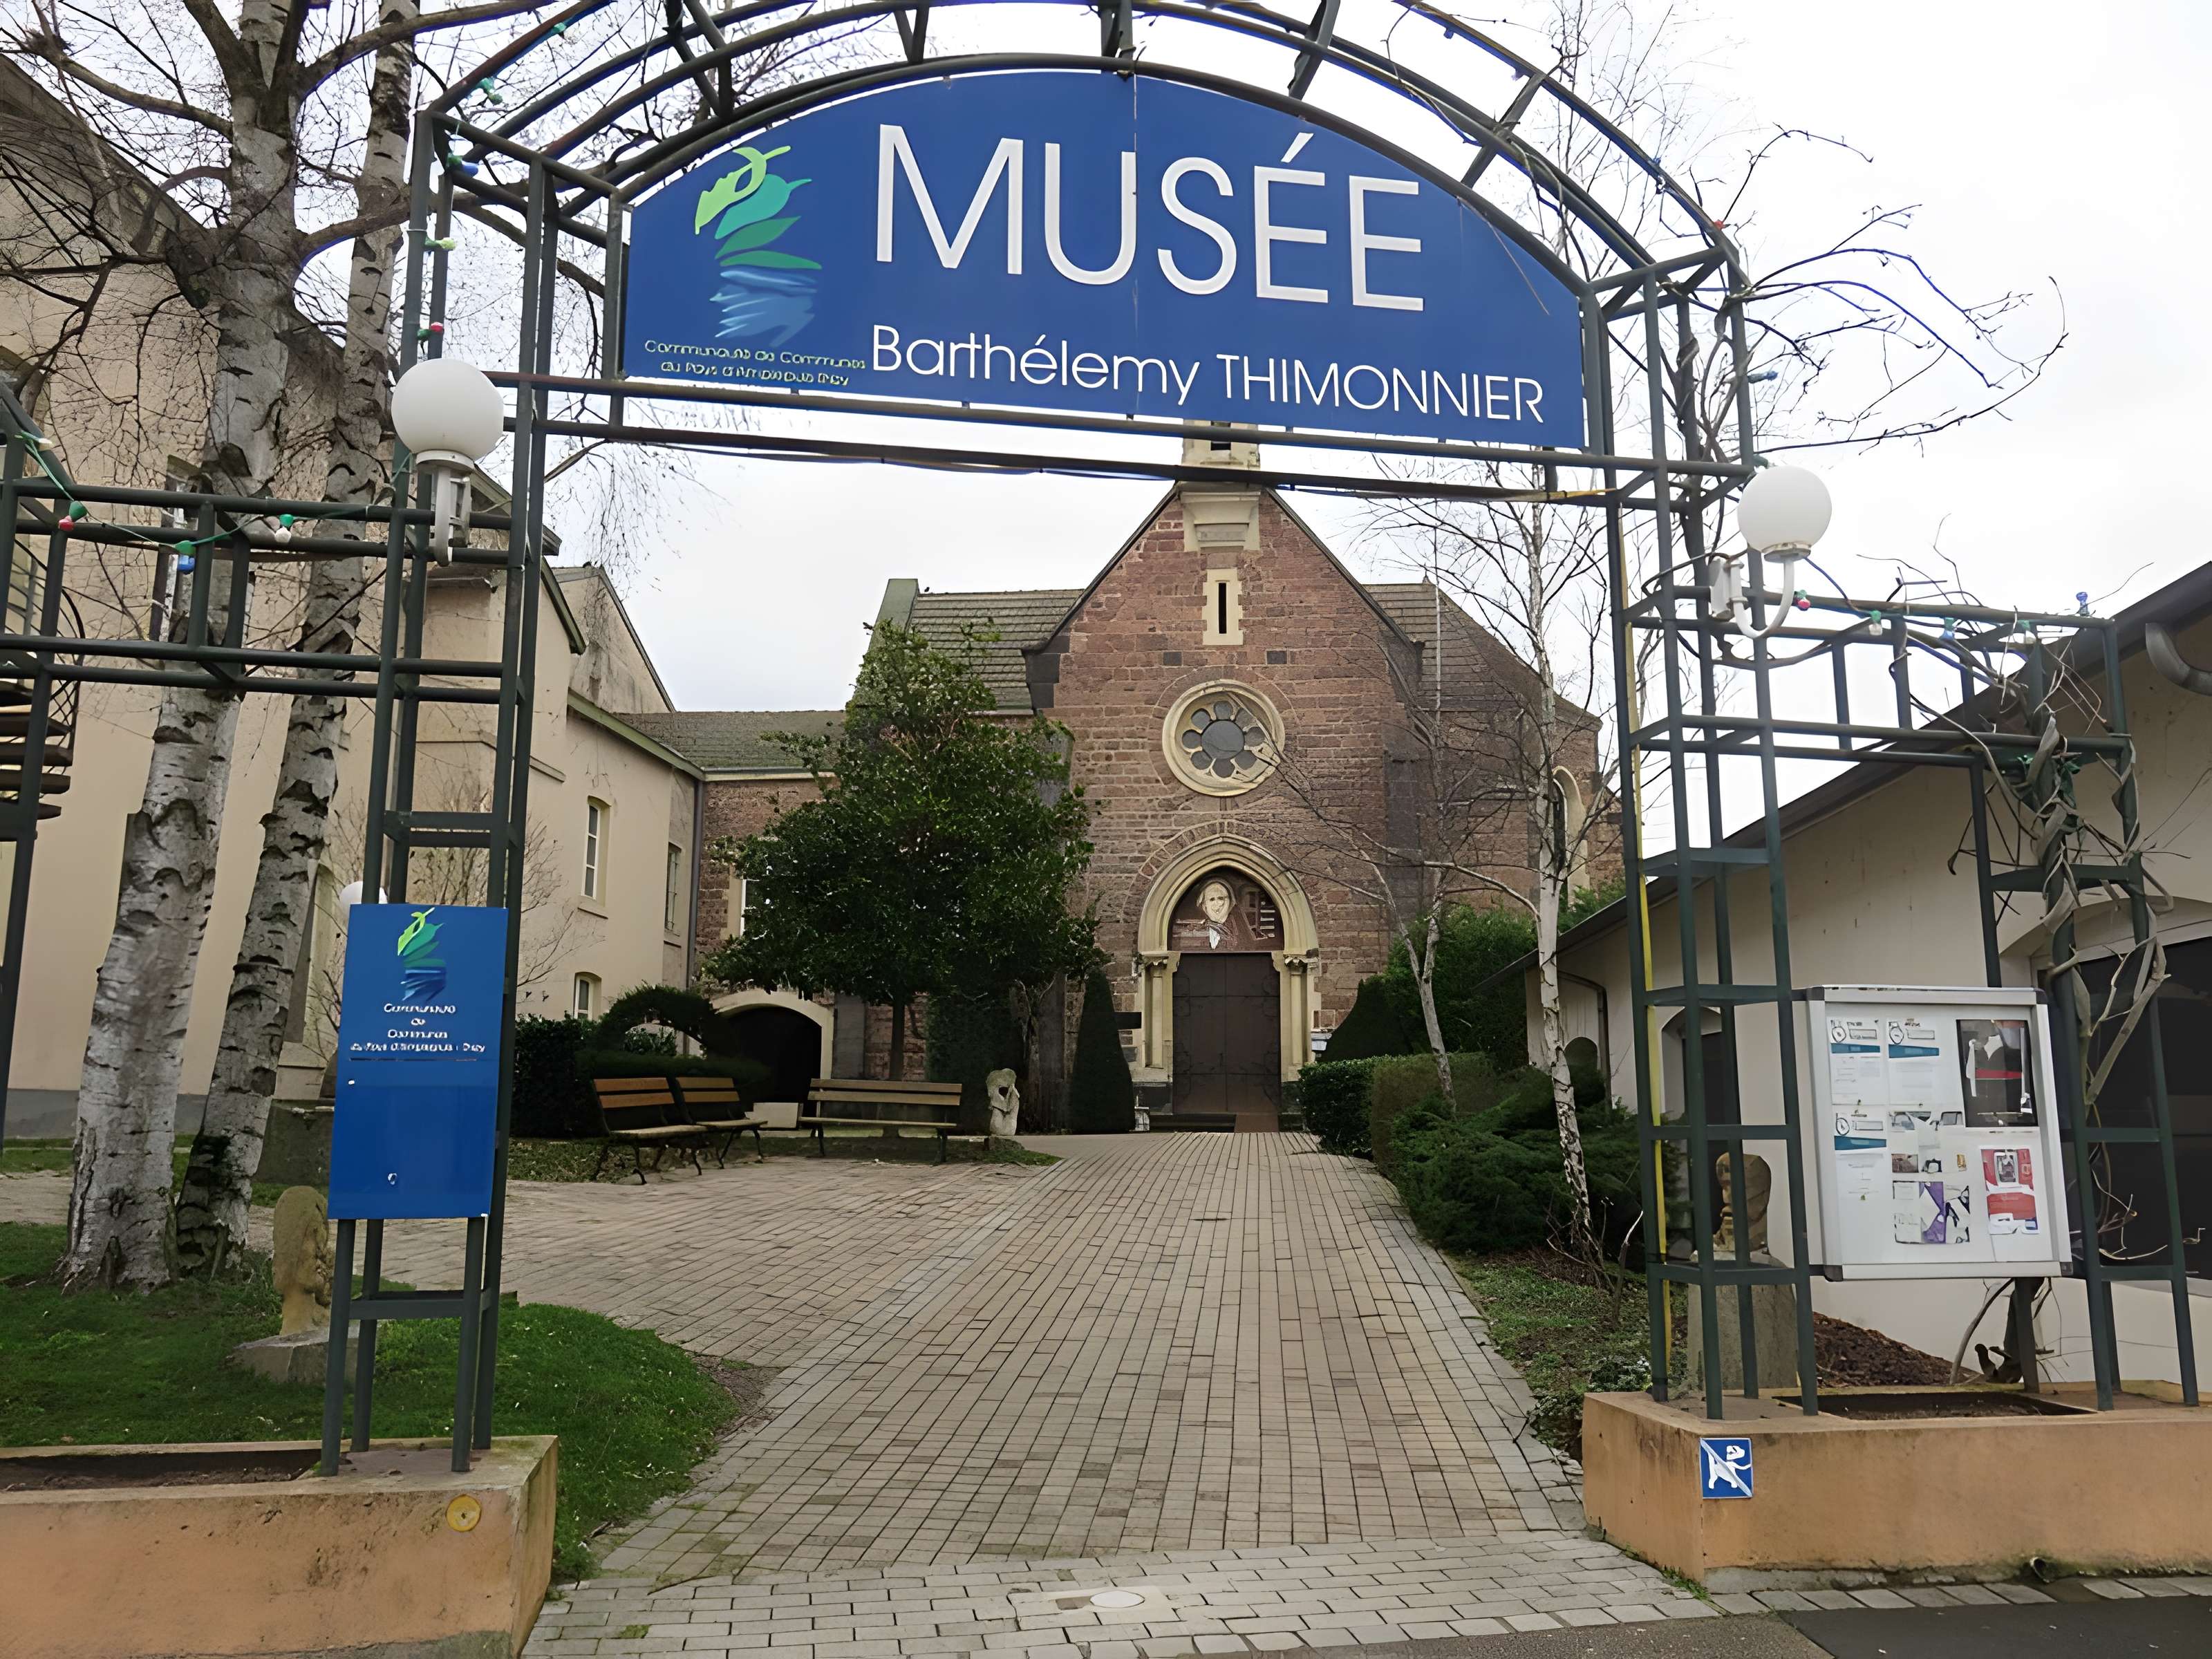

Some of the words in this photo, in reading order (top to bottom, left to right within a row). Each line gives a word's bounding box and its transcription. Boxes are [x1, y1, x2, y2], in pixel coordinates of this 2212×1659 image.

[876, 124, 1425, 312] MUSÉE
[872, 324, 1201, 406] Barthélemy
[1216, 353, 1545, 424] THIMONNIER
